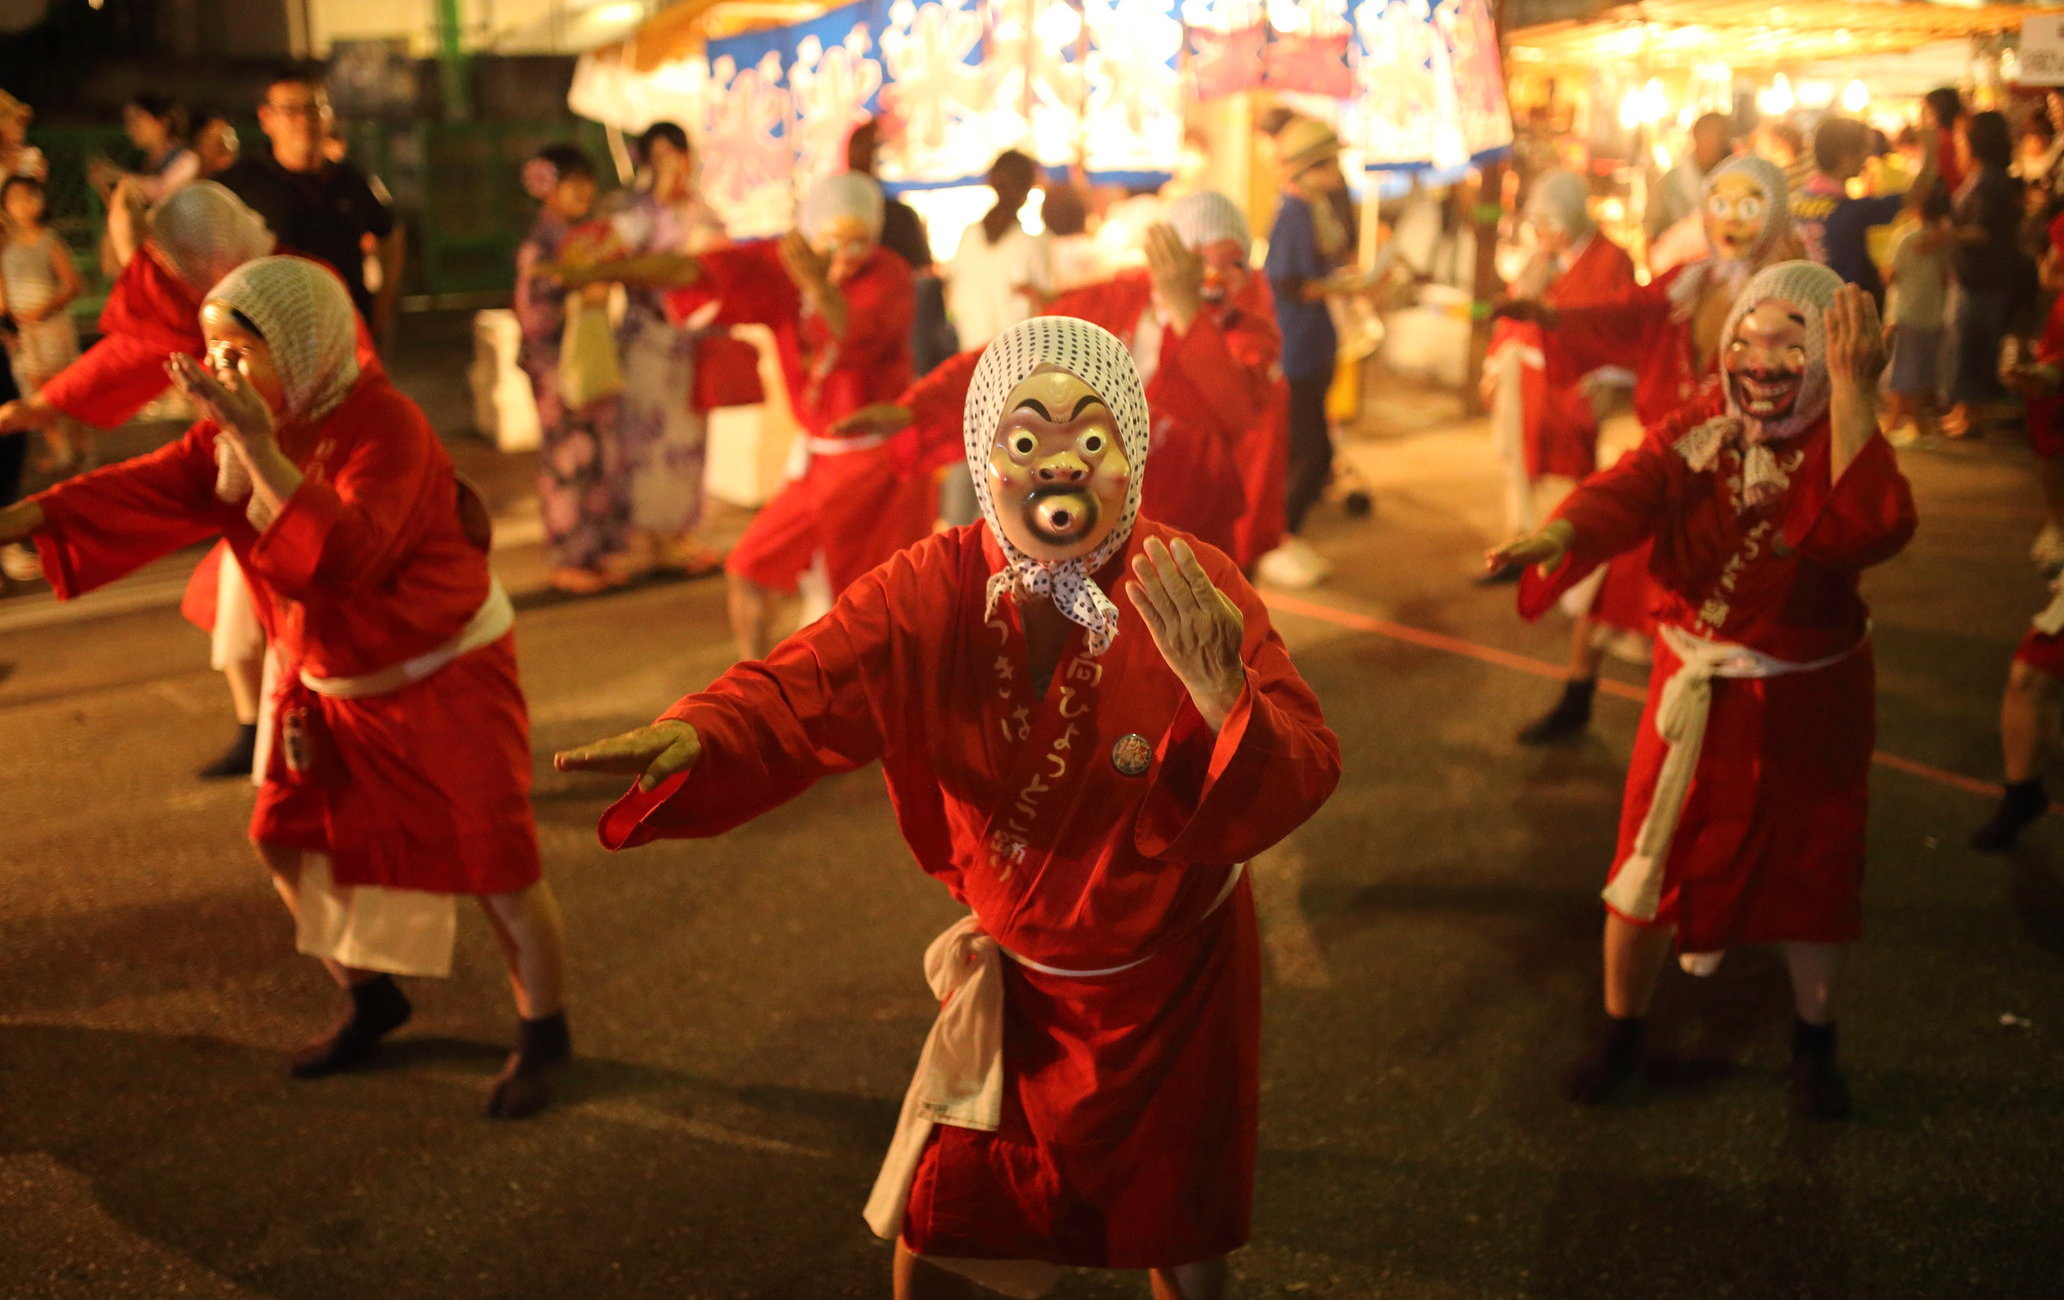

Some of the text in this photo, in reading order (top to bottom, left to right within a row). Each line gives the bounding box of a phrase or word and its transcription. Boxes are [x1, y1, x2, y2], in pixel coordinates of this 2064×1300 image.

[990, 632, 1103, 882] 向ひょっとこ踊り
